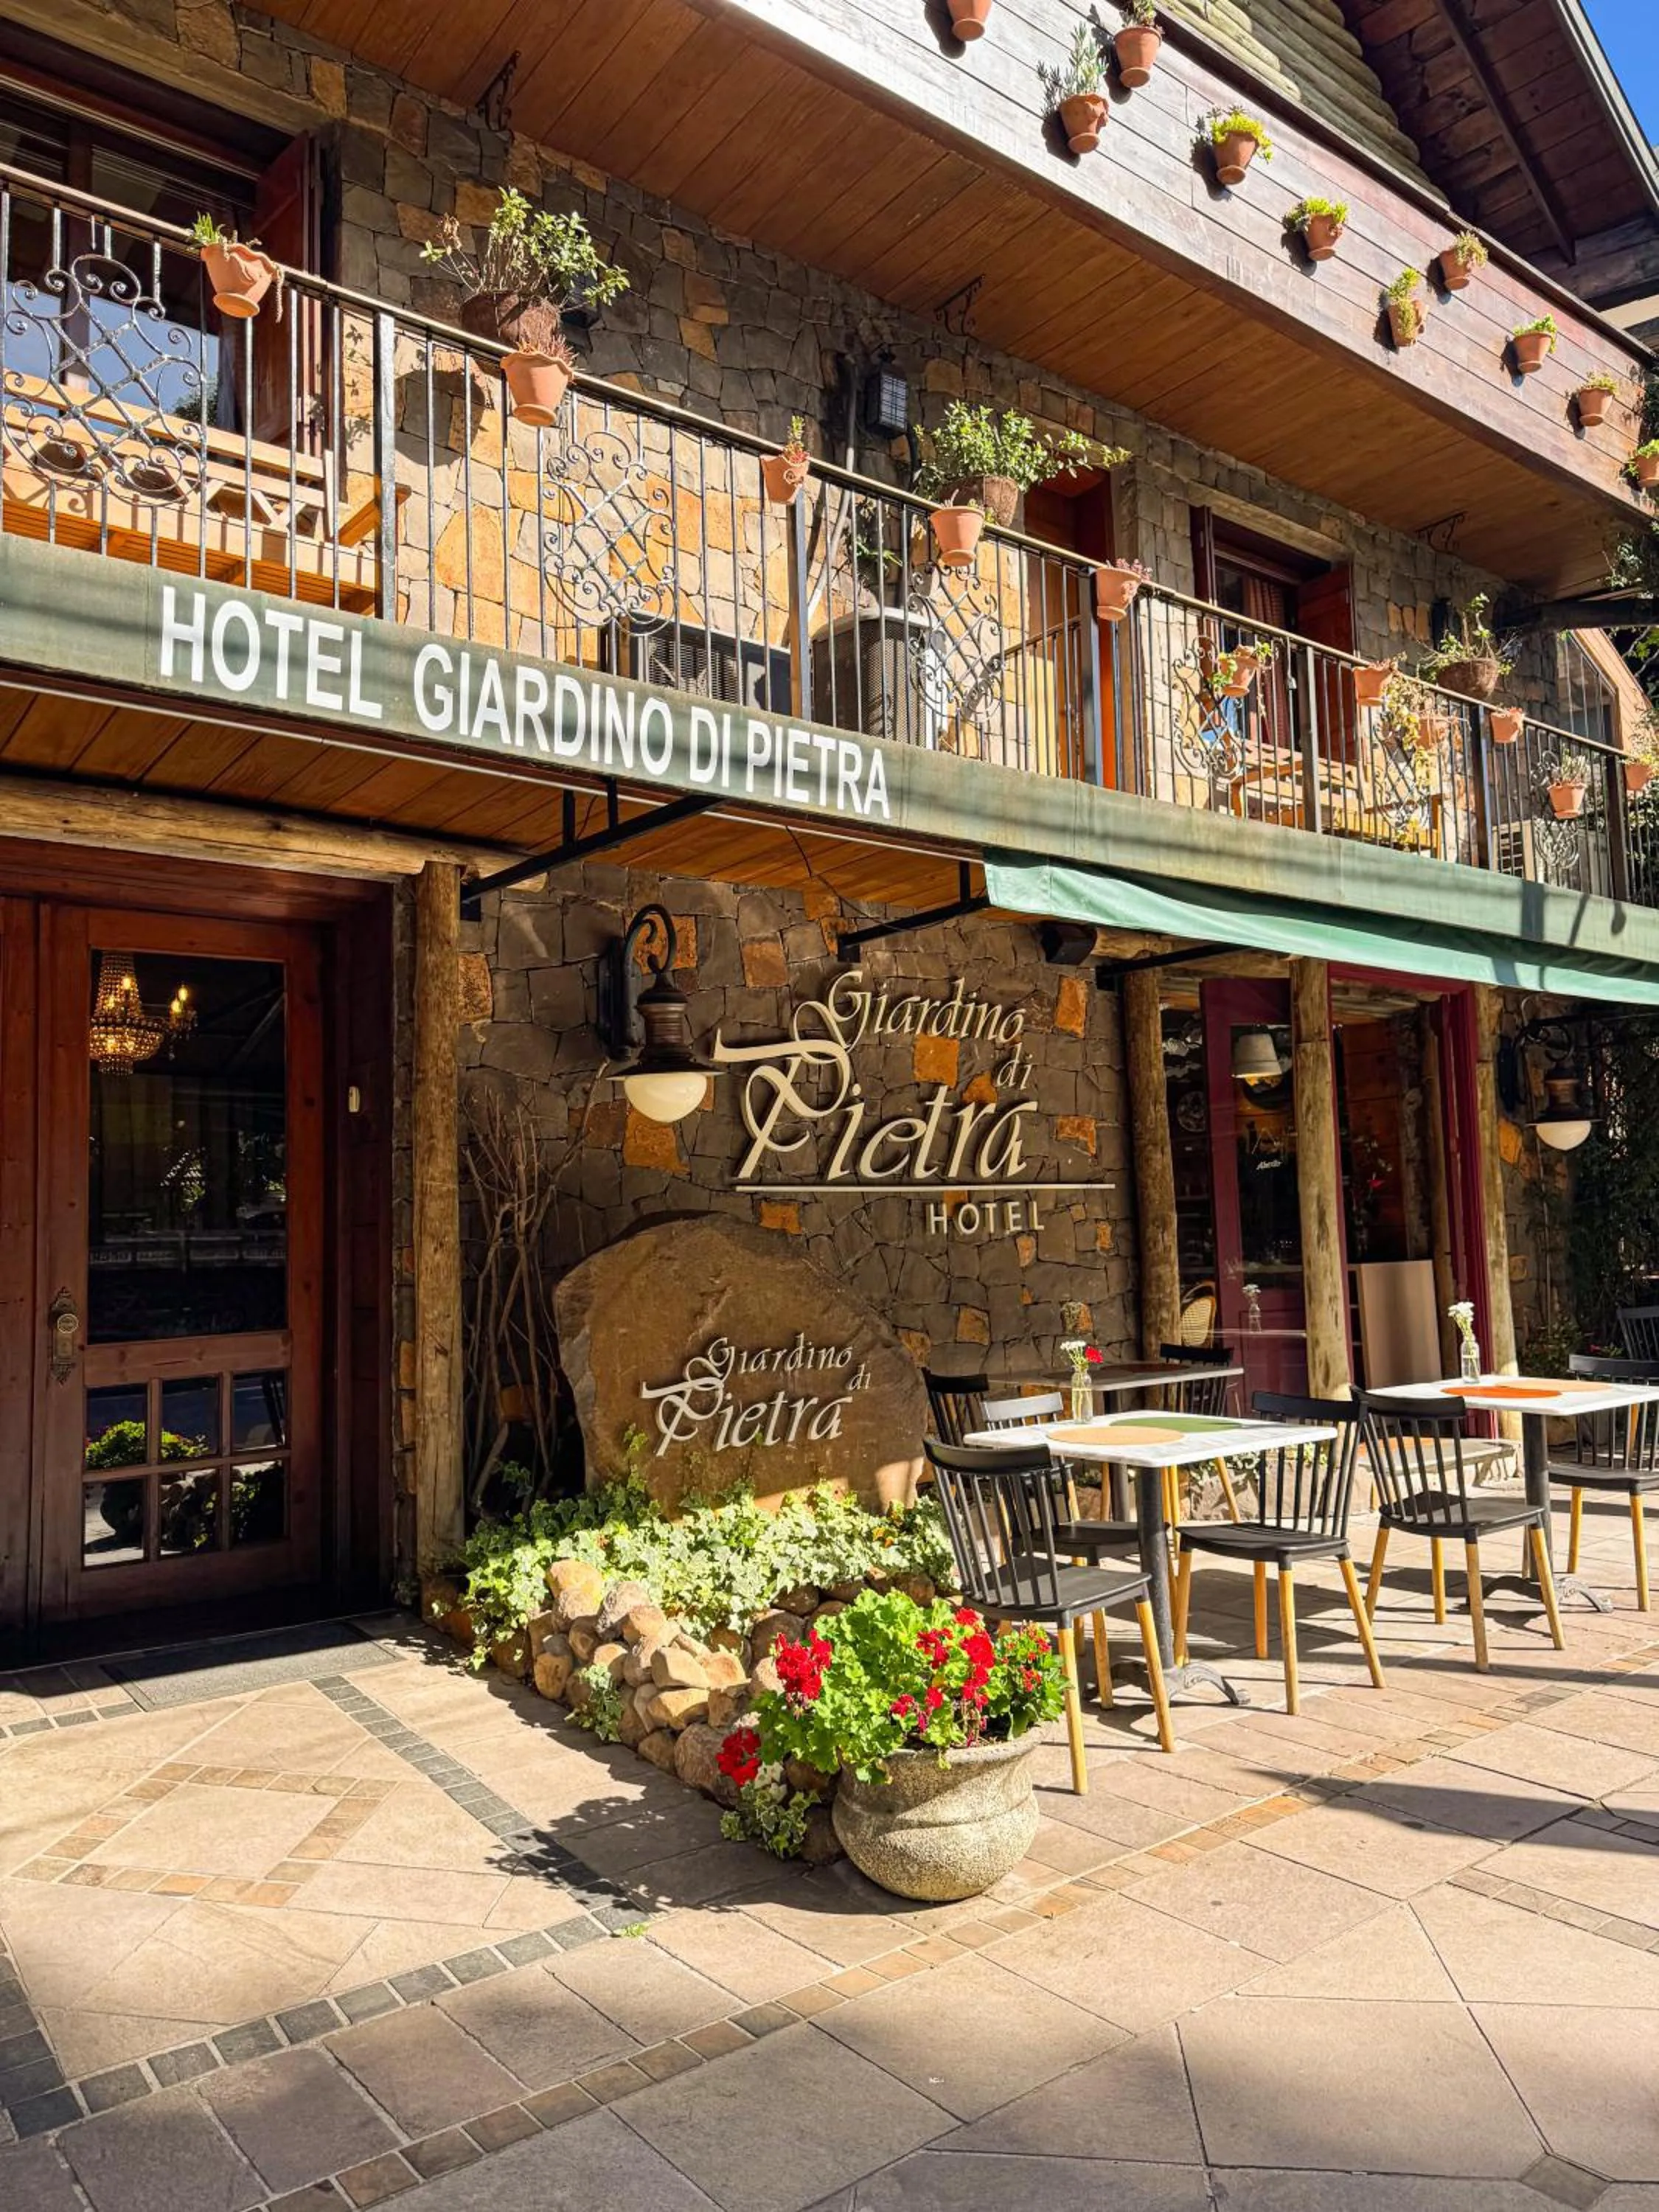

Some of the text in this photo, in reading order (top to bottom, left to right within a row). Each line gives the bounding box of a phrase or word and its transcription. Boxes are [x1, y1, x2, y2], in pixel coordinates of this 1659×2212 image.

[160, 586, 890, 819] HOTEL GIARDINO DI PIETRA
[793, 970, 1026, 1063] Giardino
[997, 1043, 1033, 1090] di
[709, 1029, 1037, 1180] Pietra
[927, 1200, 1045, 1235] HOTEL
[686, 1333, 853, 1390] Giardino
[847, 1363, 871, 1391] di
[640, 1381, 853, 1456] Pietra
